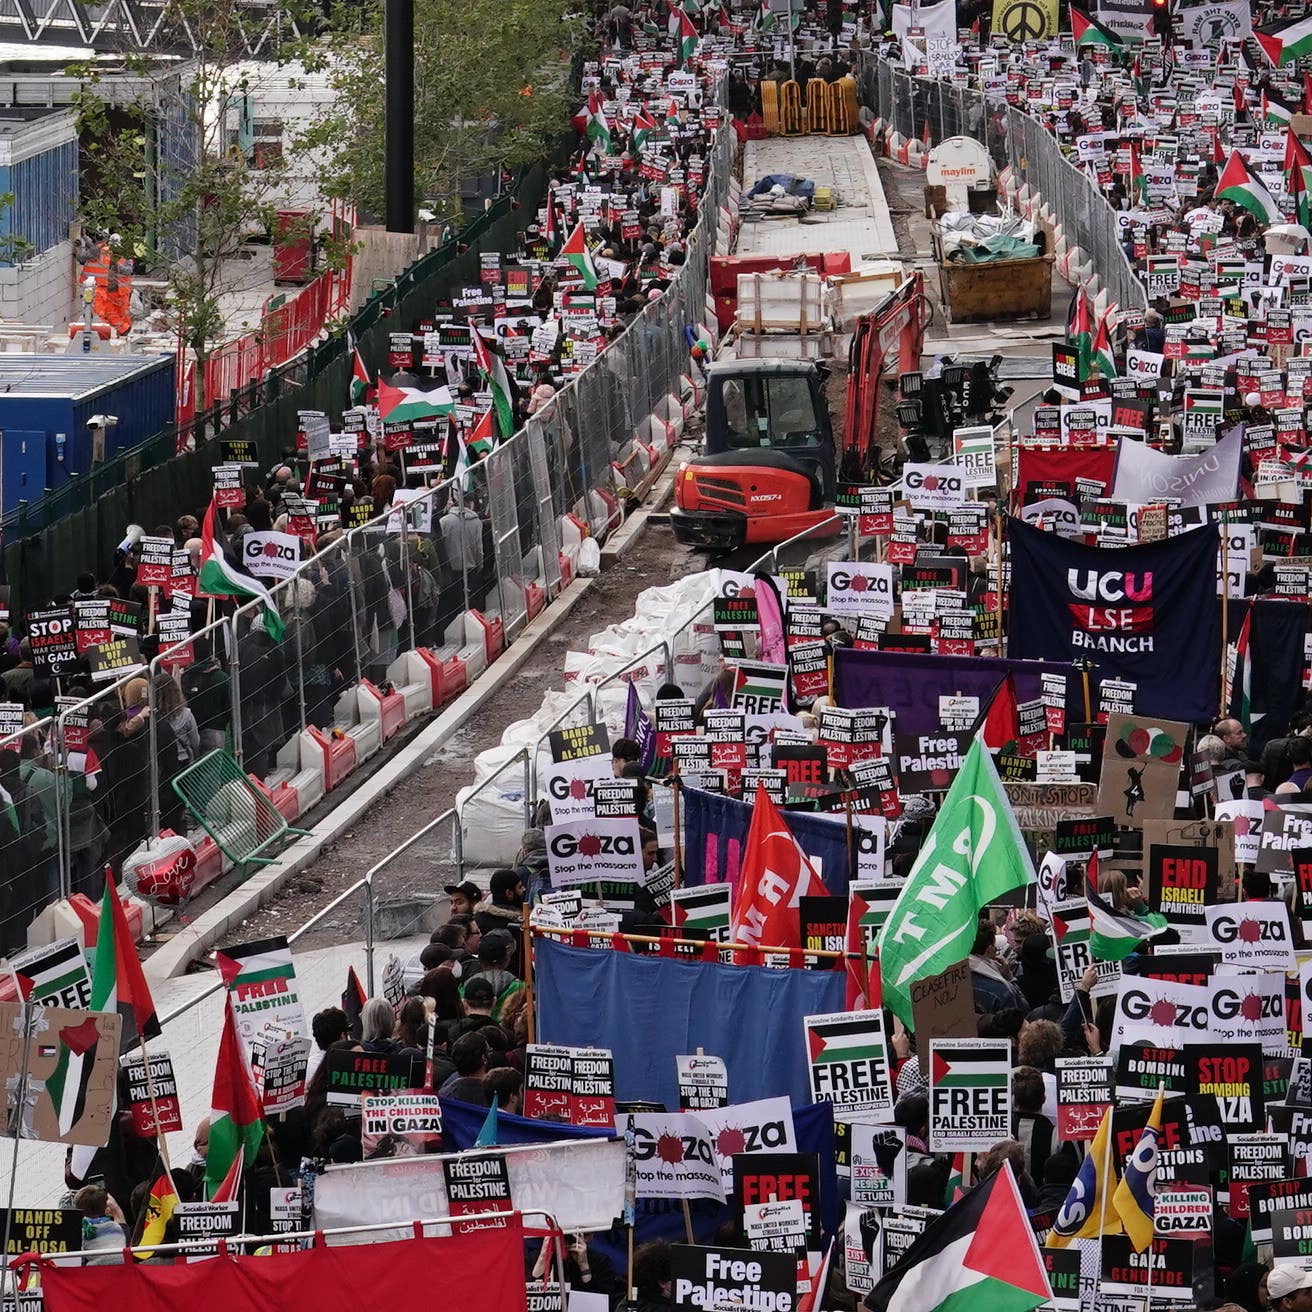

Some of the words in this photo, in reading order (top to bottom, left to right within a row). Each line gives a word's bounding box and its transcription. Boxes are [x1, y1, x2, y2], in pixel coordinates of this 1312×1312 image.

[940, 167, 976, 178] maylim
[452, 294, 493, 308] Palestine
[955, 452, 993, 469] FREE
[861, 494, 889, 503] FREEDOM
[861, 505, 891, 513] PALESTINE
[143, 544, 171, 554] FREEDOM
[141, 555, 171, 565] PALESTINE
[1067, 568, 1153, 601] UCU
[1089, 608, 1132, 631] LSE
[30, 619, 72, 636] STOP
[31, 633, 73, 647] ISRAEL'S
[99, 641, 127, 653] HANDS
[1072, 630, 1154, 653] BRANCH
[34, 654, 46, 663] IN
[47, 651, 76, 663] GAZA
[98, 656, 133, 669] AL-AQSA
[106, 650, 120, 660] OFF
[562, 725, 594, 740] HANDS
[561, 742, 601, 760] AL-AQSA
[919, 736, 957, 753] Free
[597, 787, 633, 801] FREEDOM
[596, 802, 636, 816] PALESTINE
[550, 833, 635, 858] Gza
[555, 863, 575, 874] Stop
[577, 862, 594, 872] the
[596, 861, 637, 871] massacre
[1162, 858, 1206, 888] END
[1161, 888, 1205, 902] ISRAELI
[1160, 901, 1205, 915] APARTHEID
[1211, 916, 1286, 943] Gza
[911, 965, 969, 1004] CEASEFIRE
[354, 1058, 387, 1073] FREE
[332, 1072, 407, 1087] PALESTINE
[813, 1059, 888, 1089] FREE
[366, 1097, 394, 1107] STOP
[398, 1097, 438, 1106] KILLING
[815, 1088, 888, 1105] PALESTINE
[932, 1088, 1008, 1115] FREE
[365, 1109, 386, 1117] THE
[389, 1107, 440, 1116] CHILDREN
[368, 1121, 386, 1133] IN
[393, 1118, 441, 1133] GAZA
[932, 1116, 1008, 1129] PALESTINE
[450, 1161, 501, 1177] FREEDOM
[450, 1184, 507, 1198] PALESTINE
[854, 1191, 895, 1201] RETURN.
[16, 1209, 63, 1225] HANDS
[26, 1224, 50, 1239] OFF
[459, 1218, 507, 1233] لفلسطين
[7, 1238, 67, 1253] AL-AQSA
[706, 1253, 762, 1281] Free
[676, 1280, 791, 1312] Palestine
